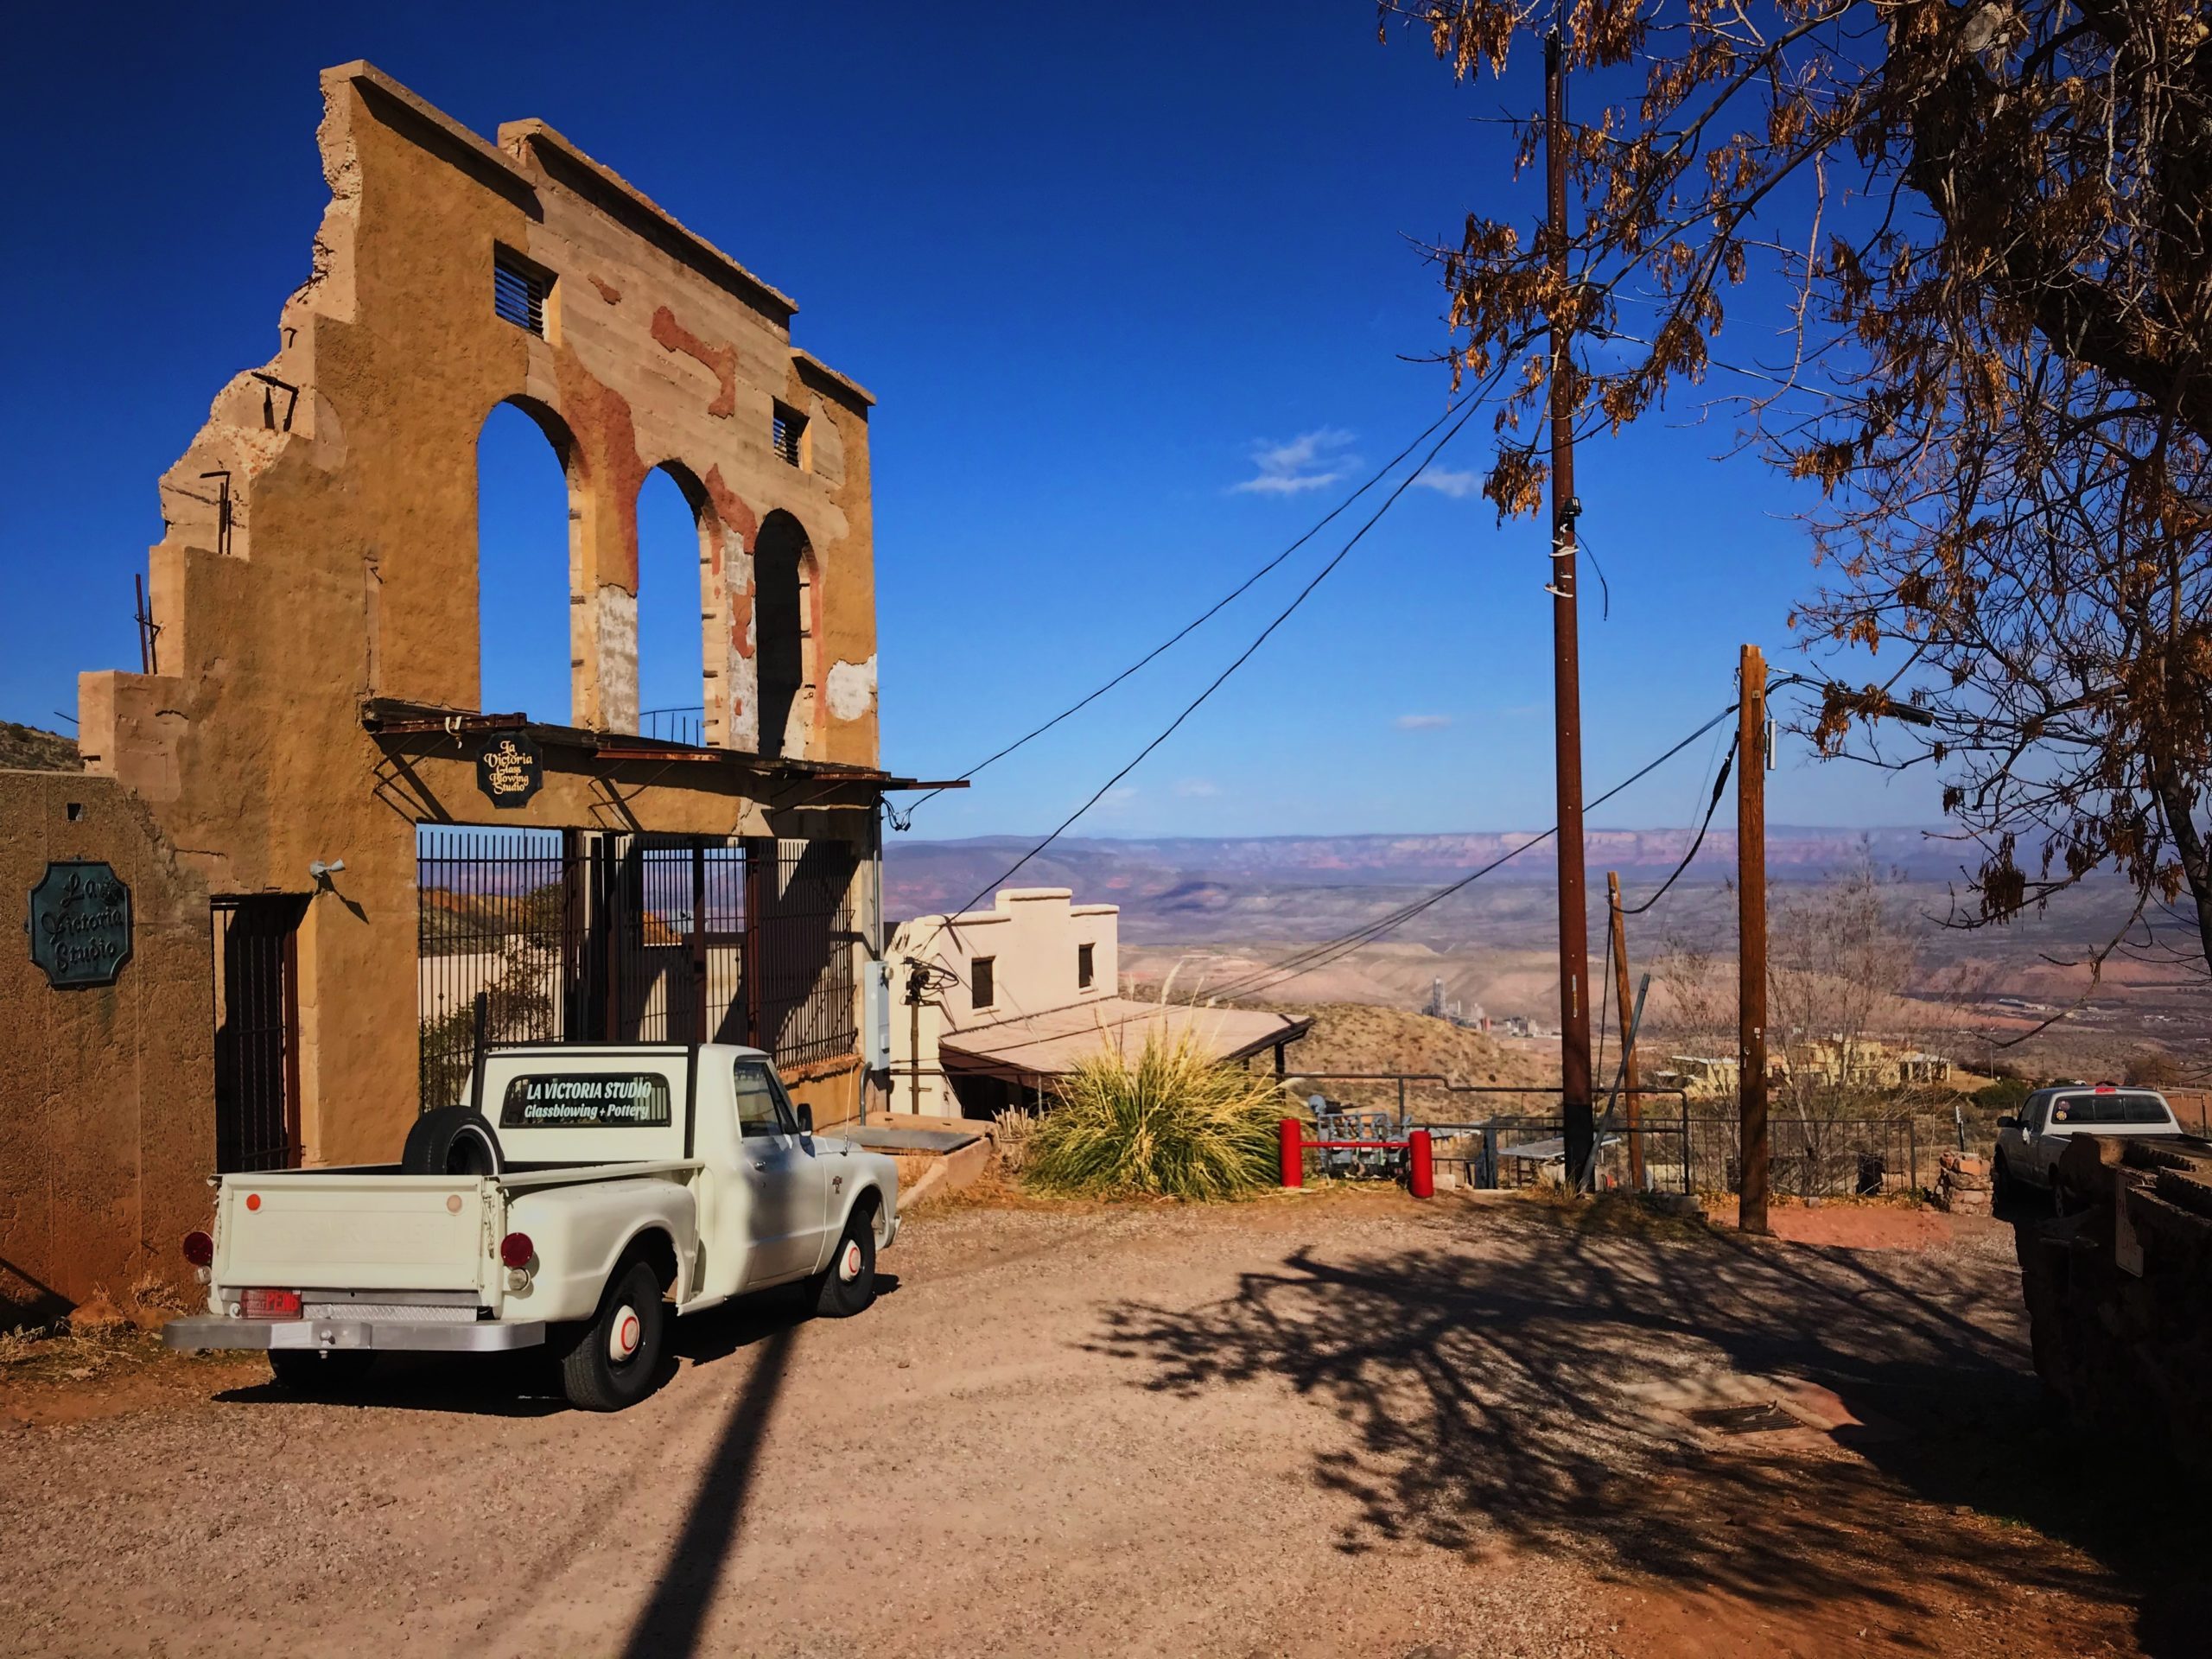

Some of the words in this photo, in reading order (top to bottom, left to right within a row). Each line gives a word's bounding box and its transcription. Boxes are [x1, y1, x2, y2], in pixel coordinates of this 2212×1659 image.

[499, 741, 517, 756] La
[484, 753, 533, 767] Victoria
[496, 763, 522, 775] Glass
[489, 772, 530, 785] Blowing
[493, 782, 525, 795] Studio
[59, 873, 98, 908] La
[41, 906, 124, 945] Victoria
[54, 937, 117, 974] Studio
[526, 1083, 542, 1100] LA
[544, 1082, 602, 1100] VICTORIA
[604, 1081, 652, 1099] STUDIO
[524, 1103, 597, 1120] Glassblowing
[607, 1103, 650, 1121] Pottery
